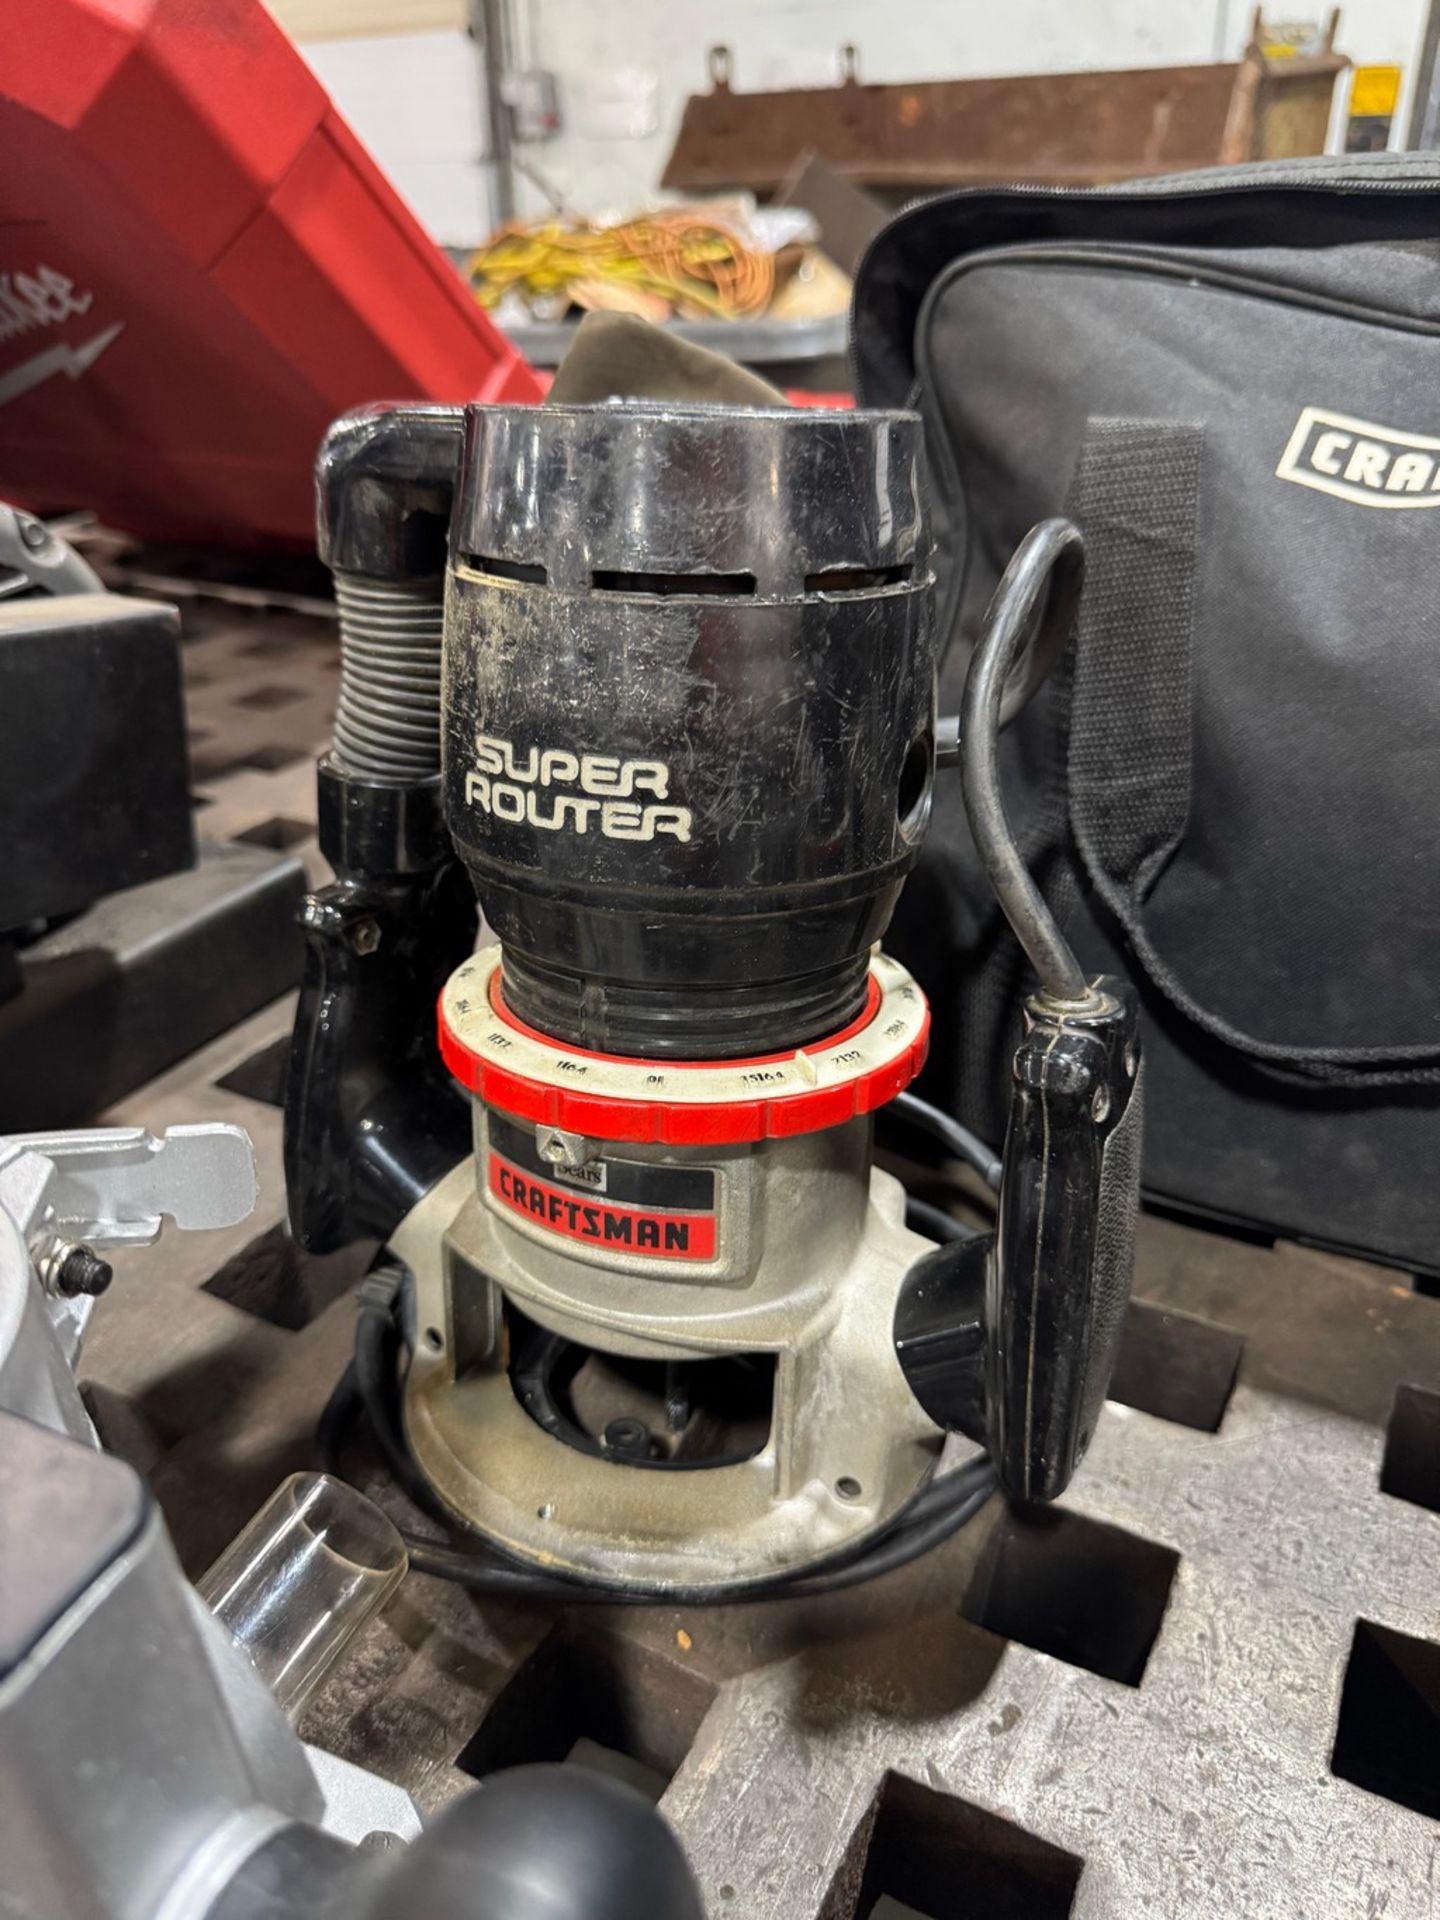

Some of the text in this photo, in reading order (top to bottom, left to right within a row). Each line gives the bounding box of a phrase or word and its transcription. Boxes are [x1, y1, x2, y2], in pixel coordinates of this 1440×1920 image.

[1310, 431, 1440, 492] CRA
[475, 735, 669, 800] SUPER
[465, 771, 692, 843] ROUTER
[500, 1167, 689, 1251] CRAFTSMAN
